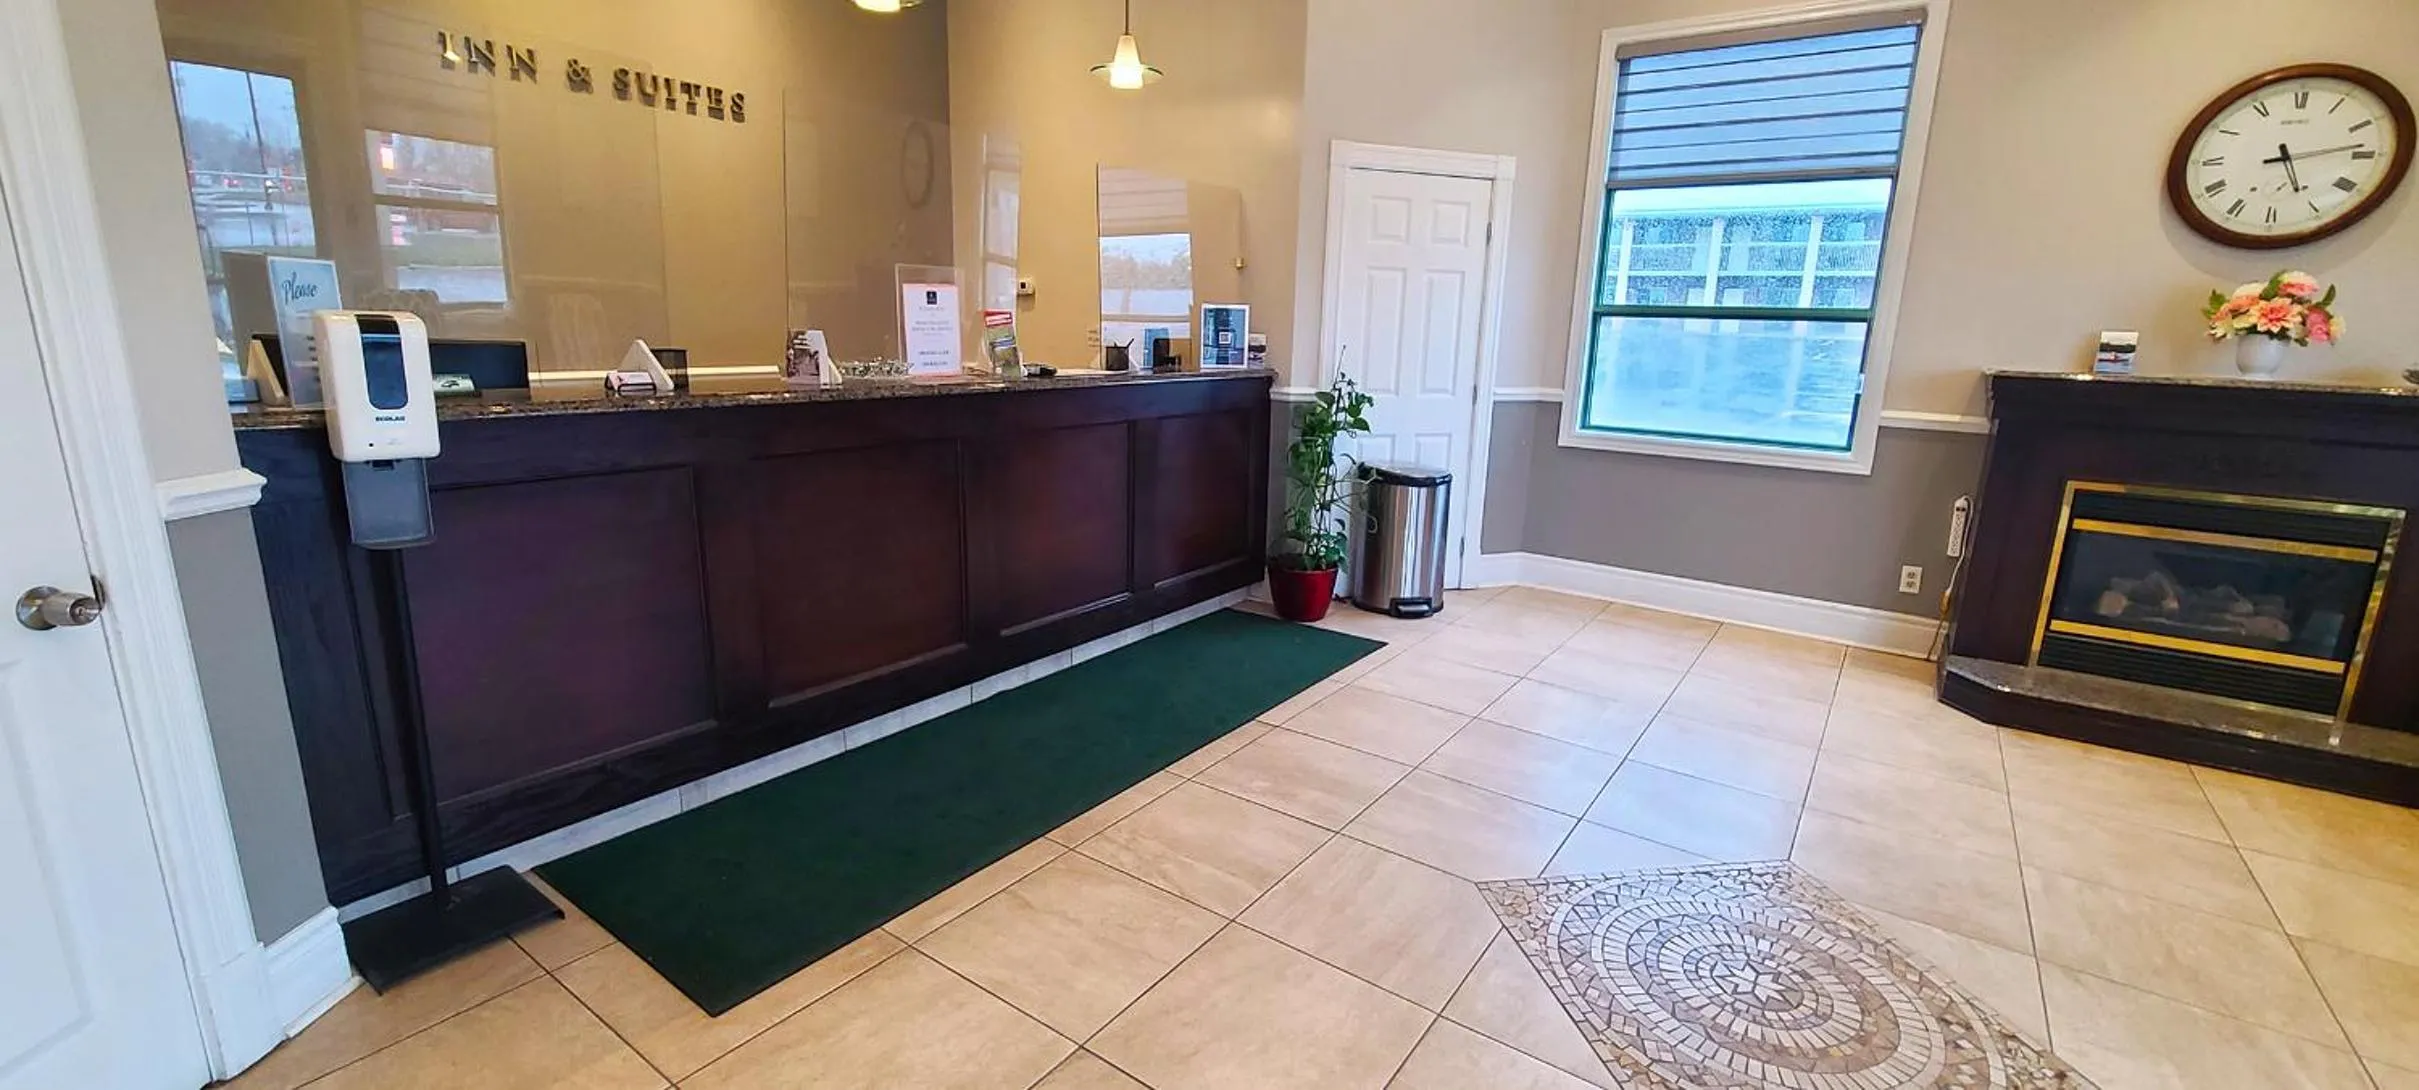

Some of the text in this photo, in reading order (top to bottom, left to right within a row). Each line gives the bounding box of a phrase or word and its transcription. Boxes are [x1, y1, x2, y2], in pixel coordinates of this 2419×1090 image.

[438, 29, 747, 123] INN & SUITES
[281, 270, 320, 305] Please
